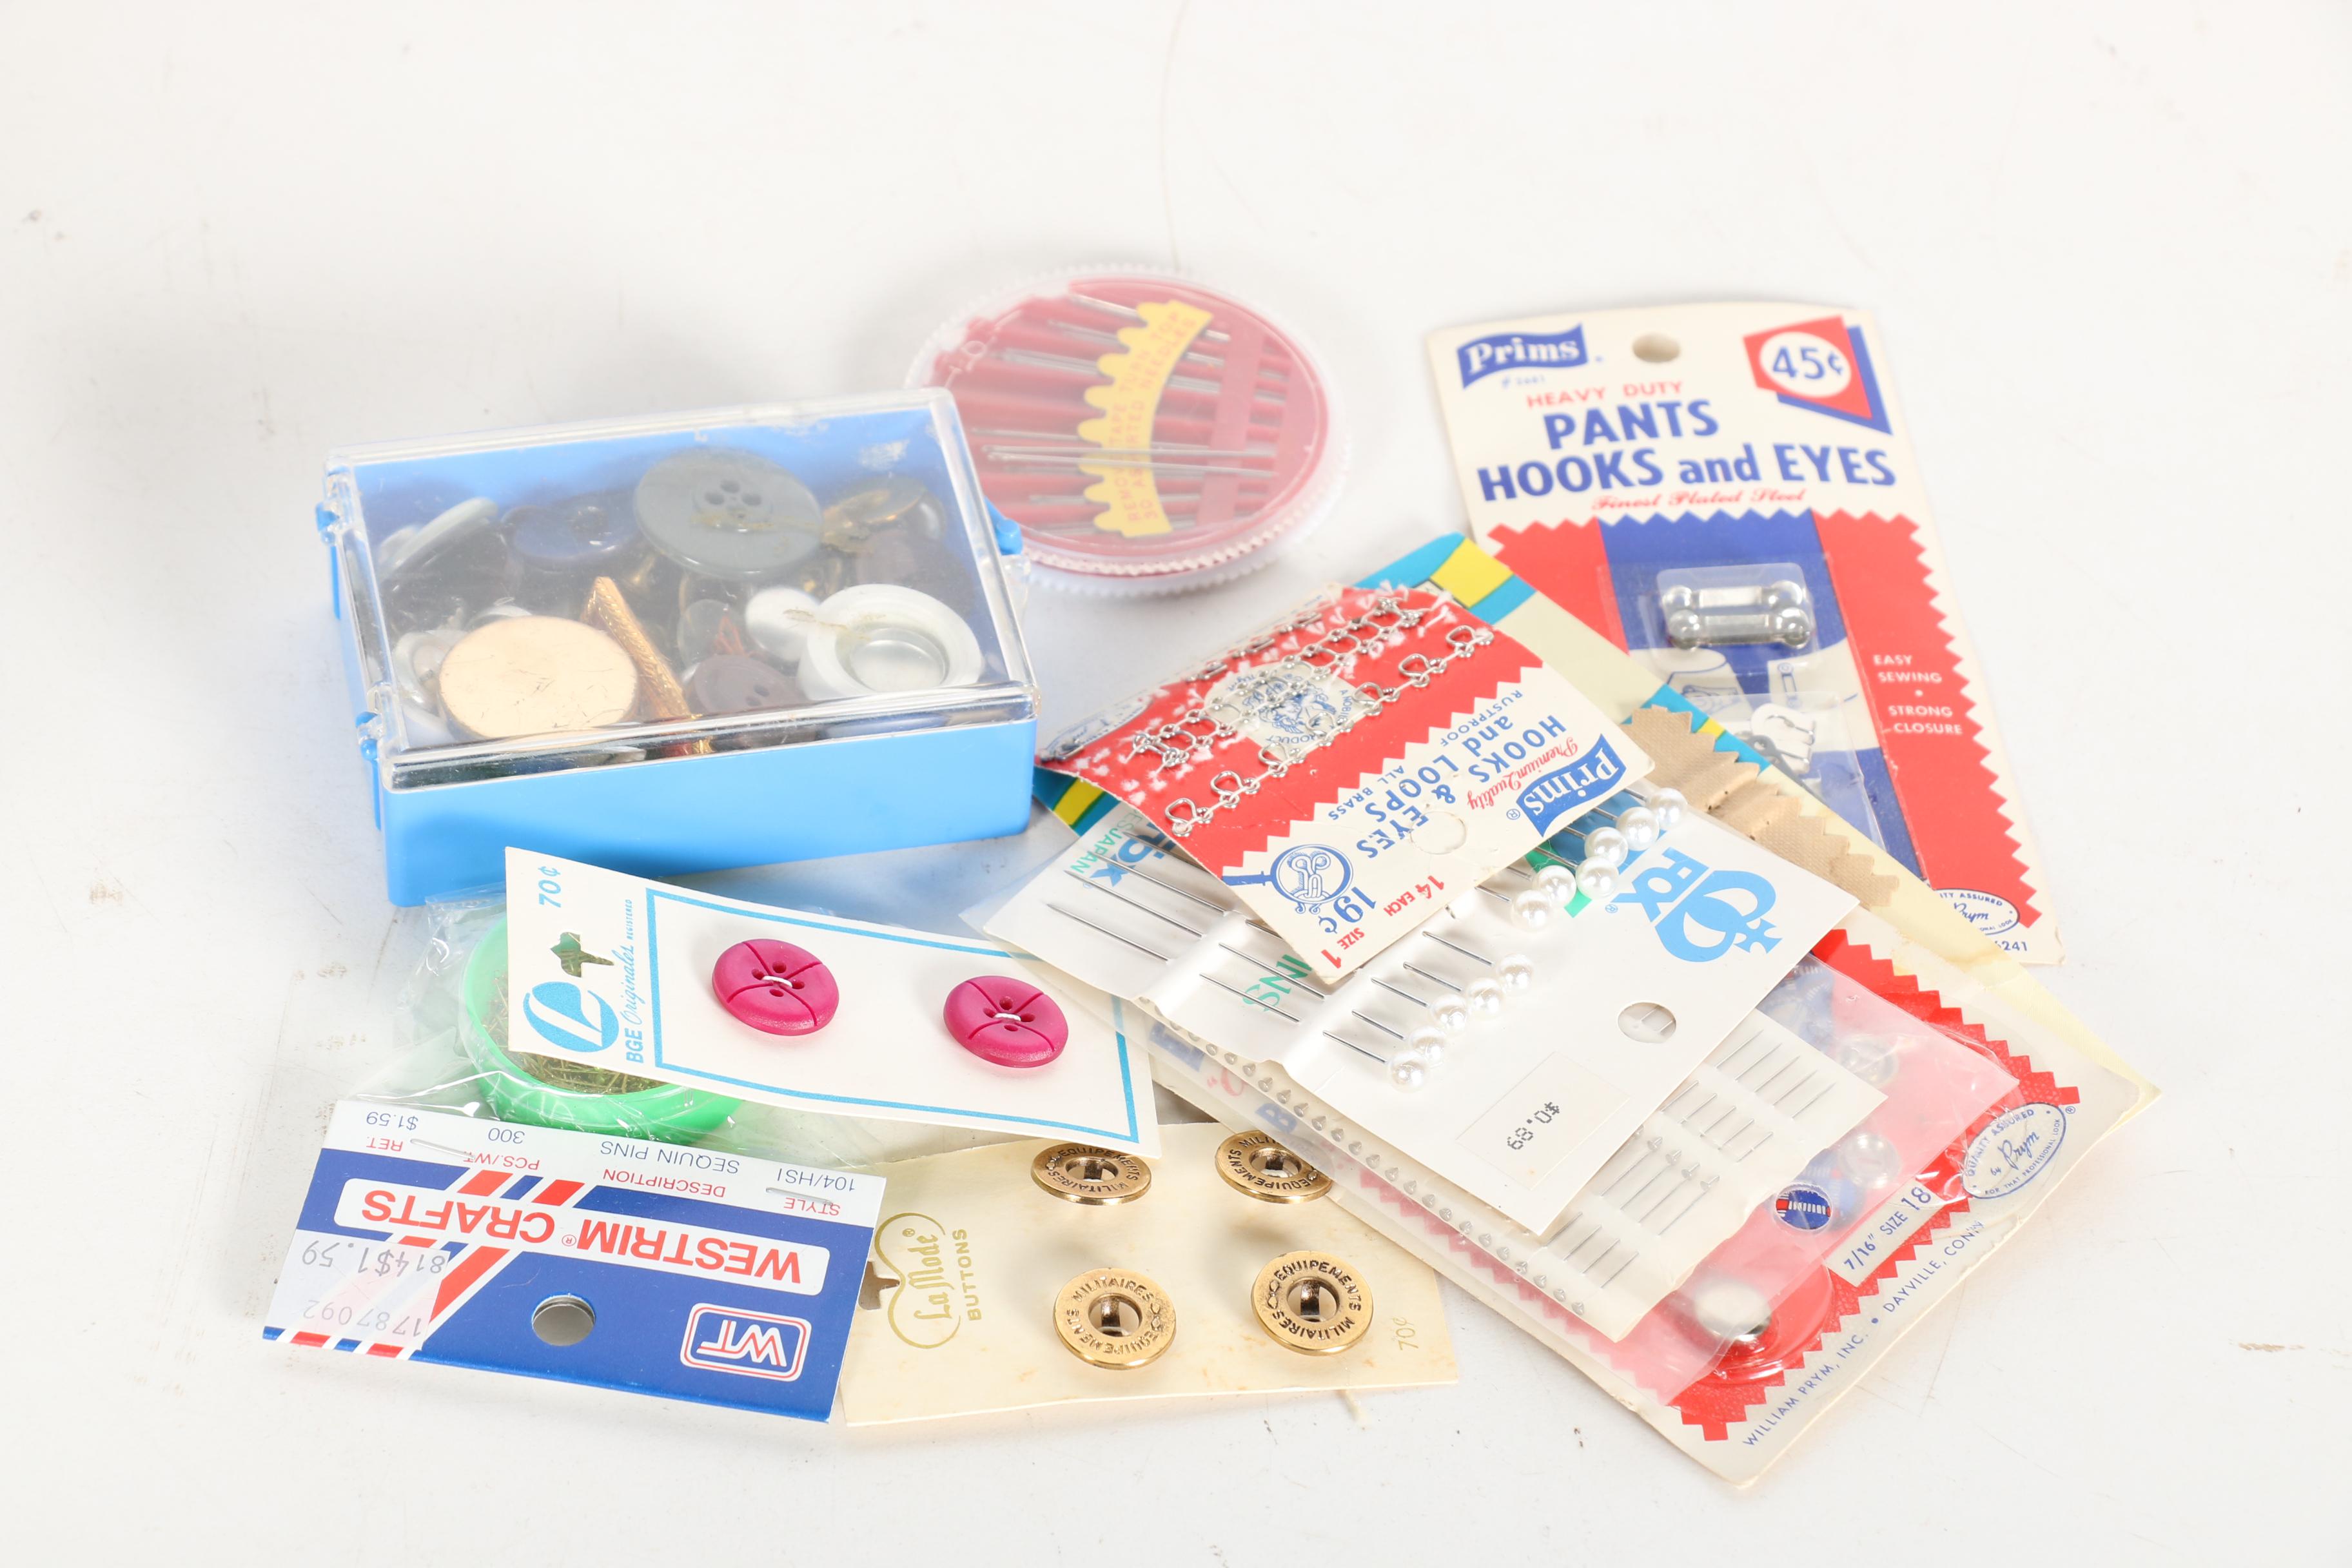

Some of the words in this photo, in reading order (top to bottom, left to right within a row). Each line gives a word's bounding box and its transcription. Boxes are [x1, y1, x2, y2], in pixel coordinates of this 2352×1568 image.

[1465, 337, 1581, 375] Prims
[1772, 346, 1845, 380] 45¢
[1527, 387, 1607, 409] HEAVY
[1623, 381, 1683, 397] DUTY
[1544, 399, 1719, 449] PANTS
[1476, 447, 1664, 502] HOOKS
[1677, 444, 1761, 484] and
[1773, 443, 1896, 487] EYES
[1591, 493, 1661, 510] Finest
[1668, 491, 1742, 507] Plated
[1750, 489, 1806, 504] Steel
[1873, 654, 1912, 666] EASY
[1877, 671, 1943, 683] SEWING
[1440, 690, 1523, 747] RUSTPROOF
[1888, 705, 1953, 717] STRONG
[1462, 716, 1514, 757] and
[1893, 722, 1963, 735] CLOSURE
[1468, 715, 1567, 783] HOOKS
[1365, 754, 1459, 823] LOOPS
[1377, 765, 1404, 785] ALL
[1524, 748, 1619, 815] Prims
[1328, 787, 1373, 820] BRASS
[1431, 785, 1456, 804] &
[1356, 805, 1429, 858] EYES
[1070, 828, 1122, 873] JAPAN
[538, 866, 561, 908] 70¢
[1384, 891, 1415, 916] EACH
[1415, 876, 1444, 899] 14
[1960, 893, 2003, 906] ASSURED
[1318, 887, 1377, 934] 19¢
[1337, 927, 1365, 950] SIZE
[1320, 949, 1342, 968] 1
[624, 1028, 643, 1063] BGE
[366, 1112, 418, 1130] $1.59
[488, 1128, 525, 1144] 300
[1507, 1102, 1560, 1150] $0.89
[366, 1136, 404, 1152] RET.
[600, 1141, 649, 1161] PINS
[656, 1148, 740, 1173] SEQUIN
[1997, 1132, 2040, 1171] Prym
[2004, 1177, 2021, 1188] THAT
[2022, 1139, 2055, 1176] PROFESSIONAL
[2053, 1119, 2061, 1135] LOOK
[602, 1168, 726, 1198] DESCRIPTION
[1228, 1149, 1311, 1190] EQUIPEMENTS
[362, 1190, 555, 1244] CRAFTS
[783, 1197, 841, 1216] STYLE
[1879, 1211, 1908, 1237] SIZE
[1901, 1187, 1932, 1217] 18
[952, 1229, 981, 1321] BUTTONS
[1274, 1260, 1362, 1311] EQUIPEMENTS
[303, 1299, 421, 1337] 1787092
[1272, 1309, 1355, 1340] MILITAIRES
[1742, 1396, 1799, 1447] WILLIAM
[1798, 1362, 1839, 1395] PRYM,
[1836, 1331, 1868, 1360] INC.
[1884, 1259, 1947, 1314] DAYVILLE,
